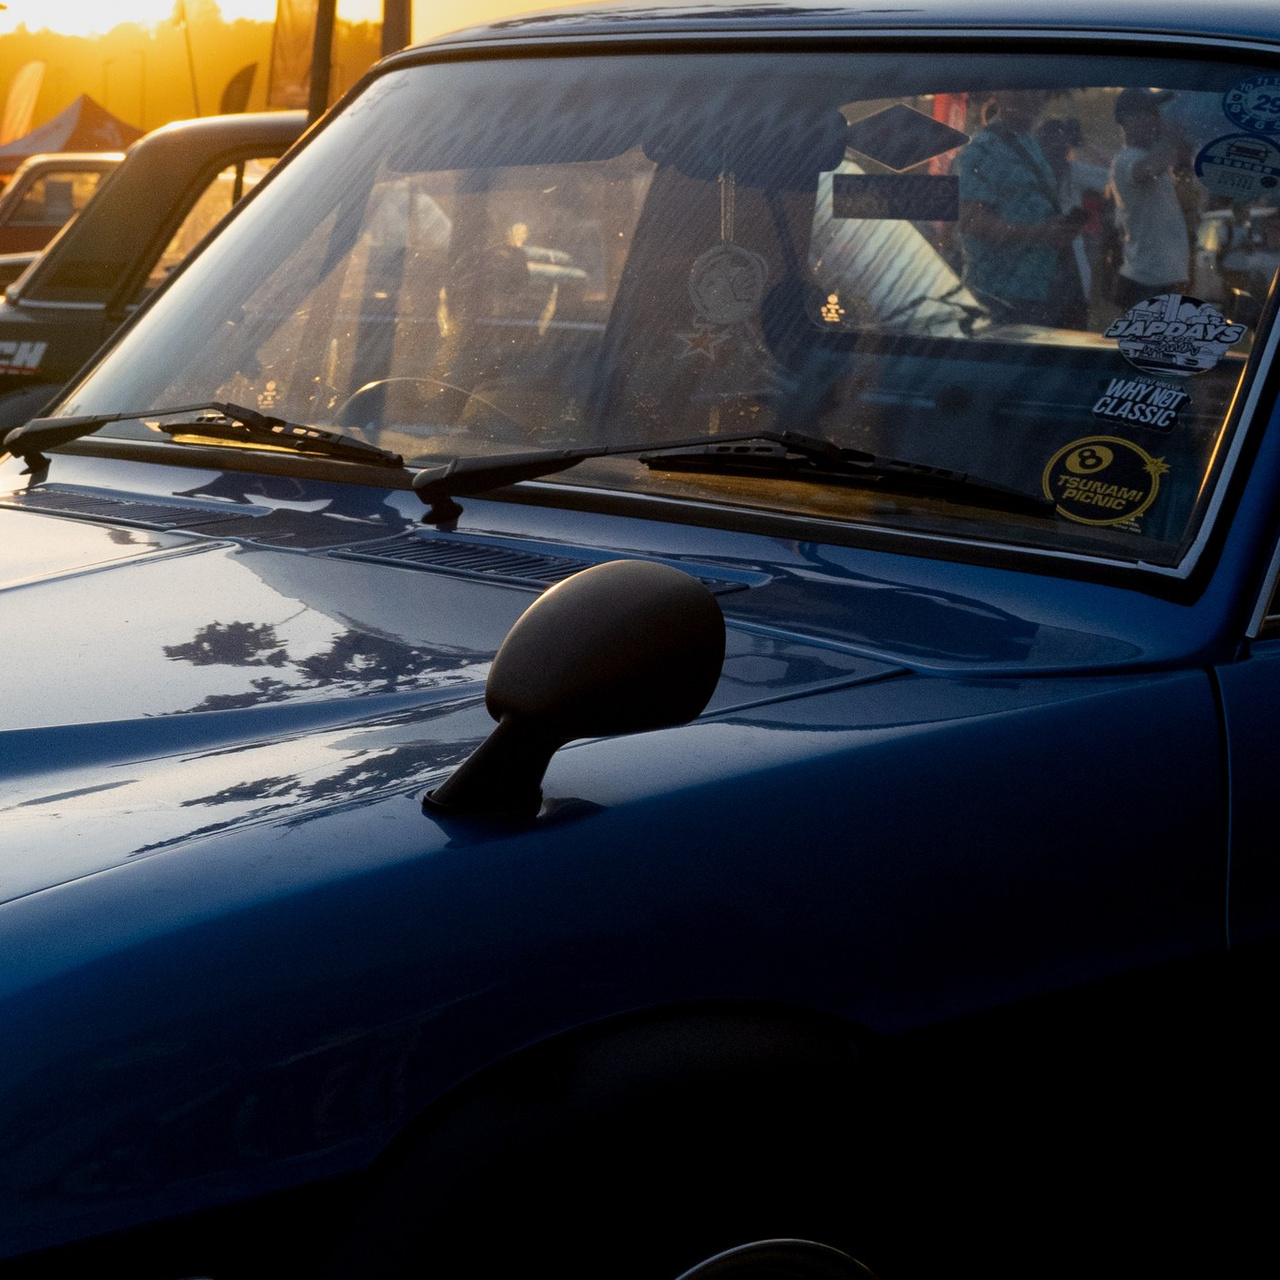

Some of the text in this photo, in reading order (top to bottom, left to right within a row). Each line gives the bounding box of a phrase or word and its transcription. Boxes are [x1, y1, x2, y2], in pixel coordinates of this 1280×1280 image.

[1107, 319, 1245, 344] JAPDAYS
[1105, 378, 1154, 402] WHY
[1092, 396, 1177, 428] CLASSIC
[1057, 474, 1144, 503] TSUNAMI
[1062, 487, 1127, 511] PICNIC
